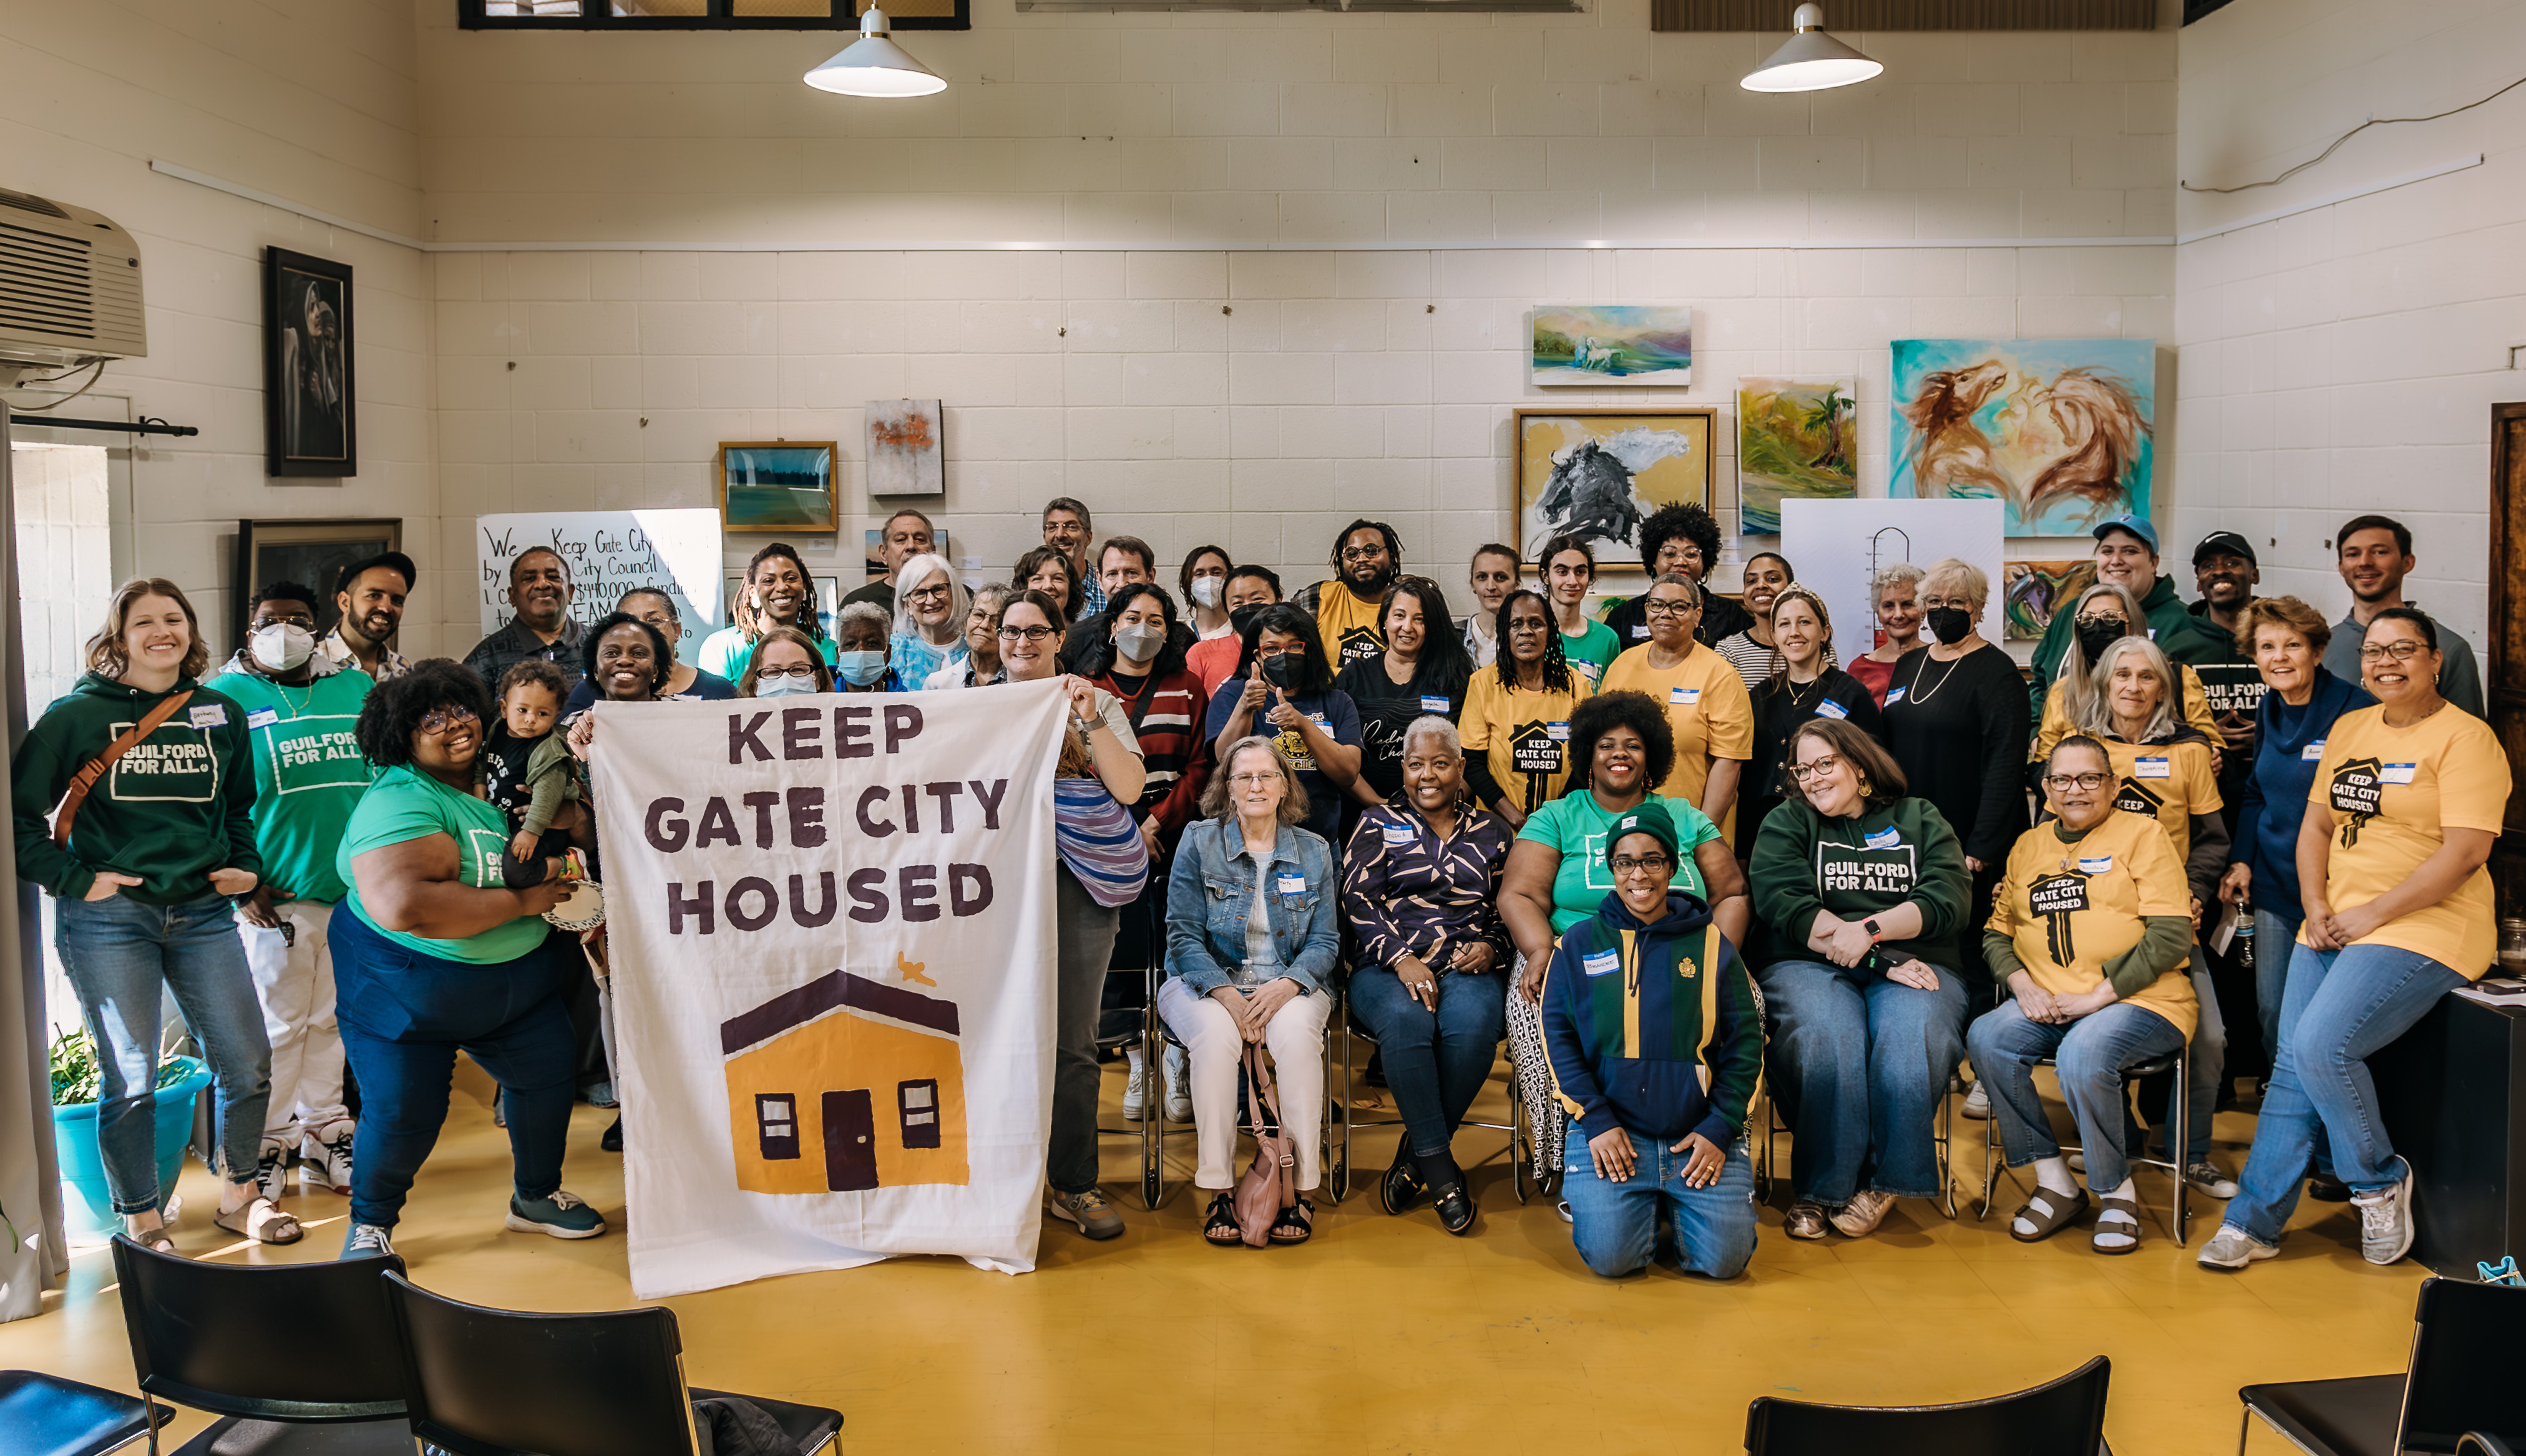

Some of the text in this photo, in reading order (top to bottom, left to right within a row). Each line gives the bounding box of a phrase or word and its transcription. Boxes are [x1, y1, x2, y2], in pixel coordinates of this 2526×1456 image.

[484, 527, 518, 557] We
[552, 528, 587, 561] Keep
[595, 530, 623, 553] Gate
[628, 528, 652, 560] City
[484, 560, 502, 588] by
[572, 556, 601, 583] City
[608, 553, 658, 575] Council
[728, 704, 924, 765] KEEP
[278, 732, 358, 754] GUILFOR
[1528, 739, 1552, 749] KEEP
[123, 744, 207, 759] GUILFORD
[282, 745, 361, 768] FOR ALL
[1515, 749, 1561, 759] GATE CITY
[121, 759, 200, 774] FOR ALL
[1521, 760, 1556, 769] HOUSED
[2348, 773, 2372, 786] KEEP
[2331, 783, 2381, 801] GATE CITY
[2117, 799, 2144, 810] KEEP
[2336, 797, 2374, 812] HOUSED
[645, 779, 1007, 853] GATE CITY
[1824, 861, 1909, 878] GUILFORD
[1825, 876, 1899, 892] FOR ALL
[2047, 879, 2075, 888] KEEP
[668, 863, 993, 934] HOUSED
[2032, 885, 2085, 902] GATE CITY
[2037, 898, 2082, 911] HOUSED
